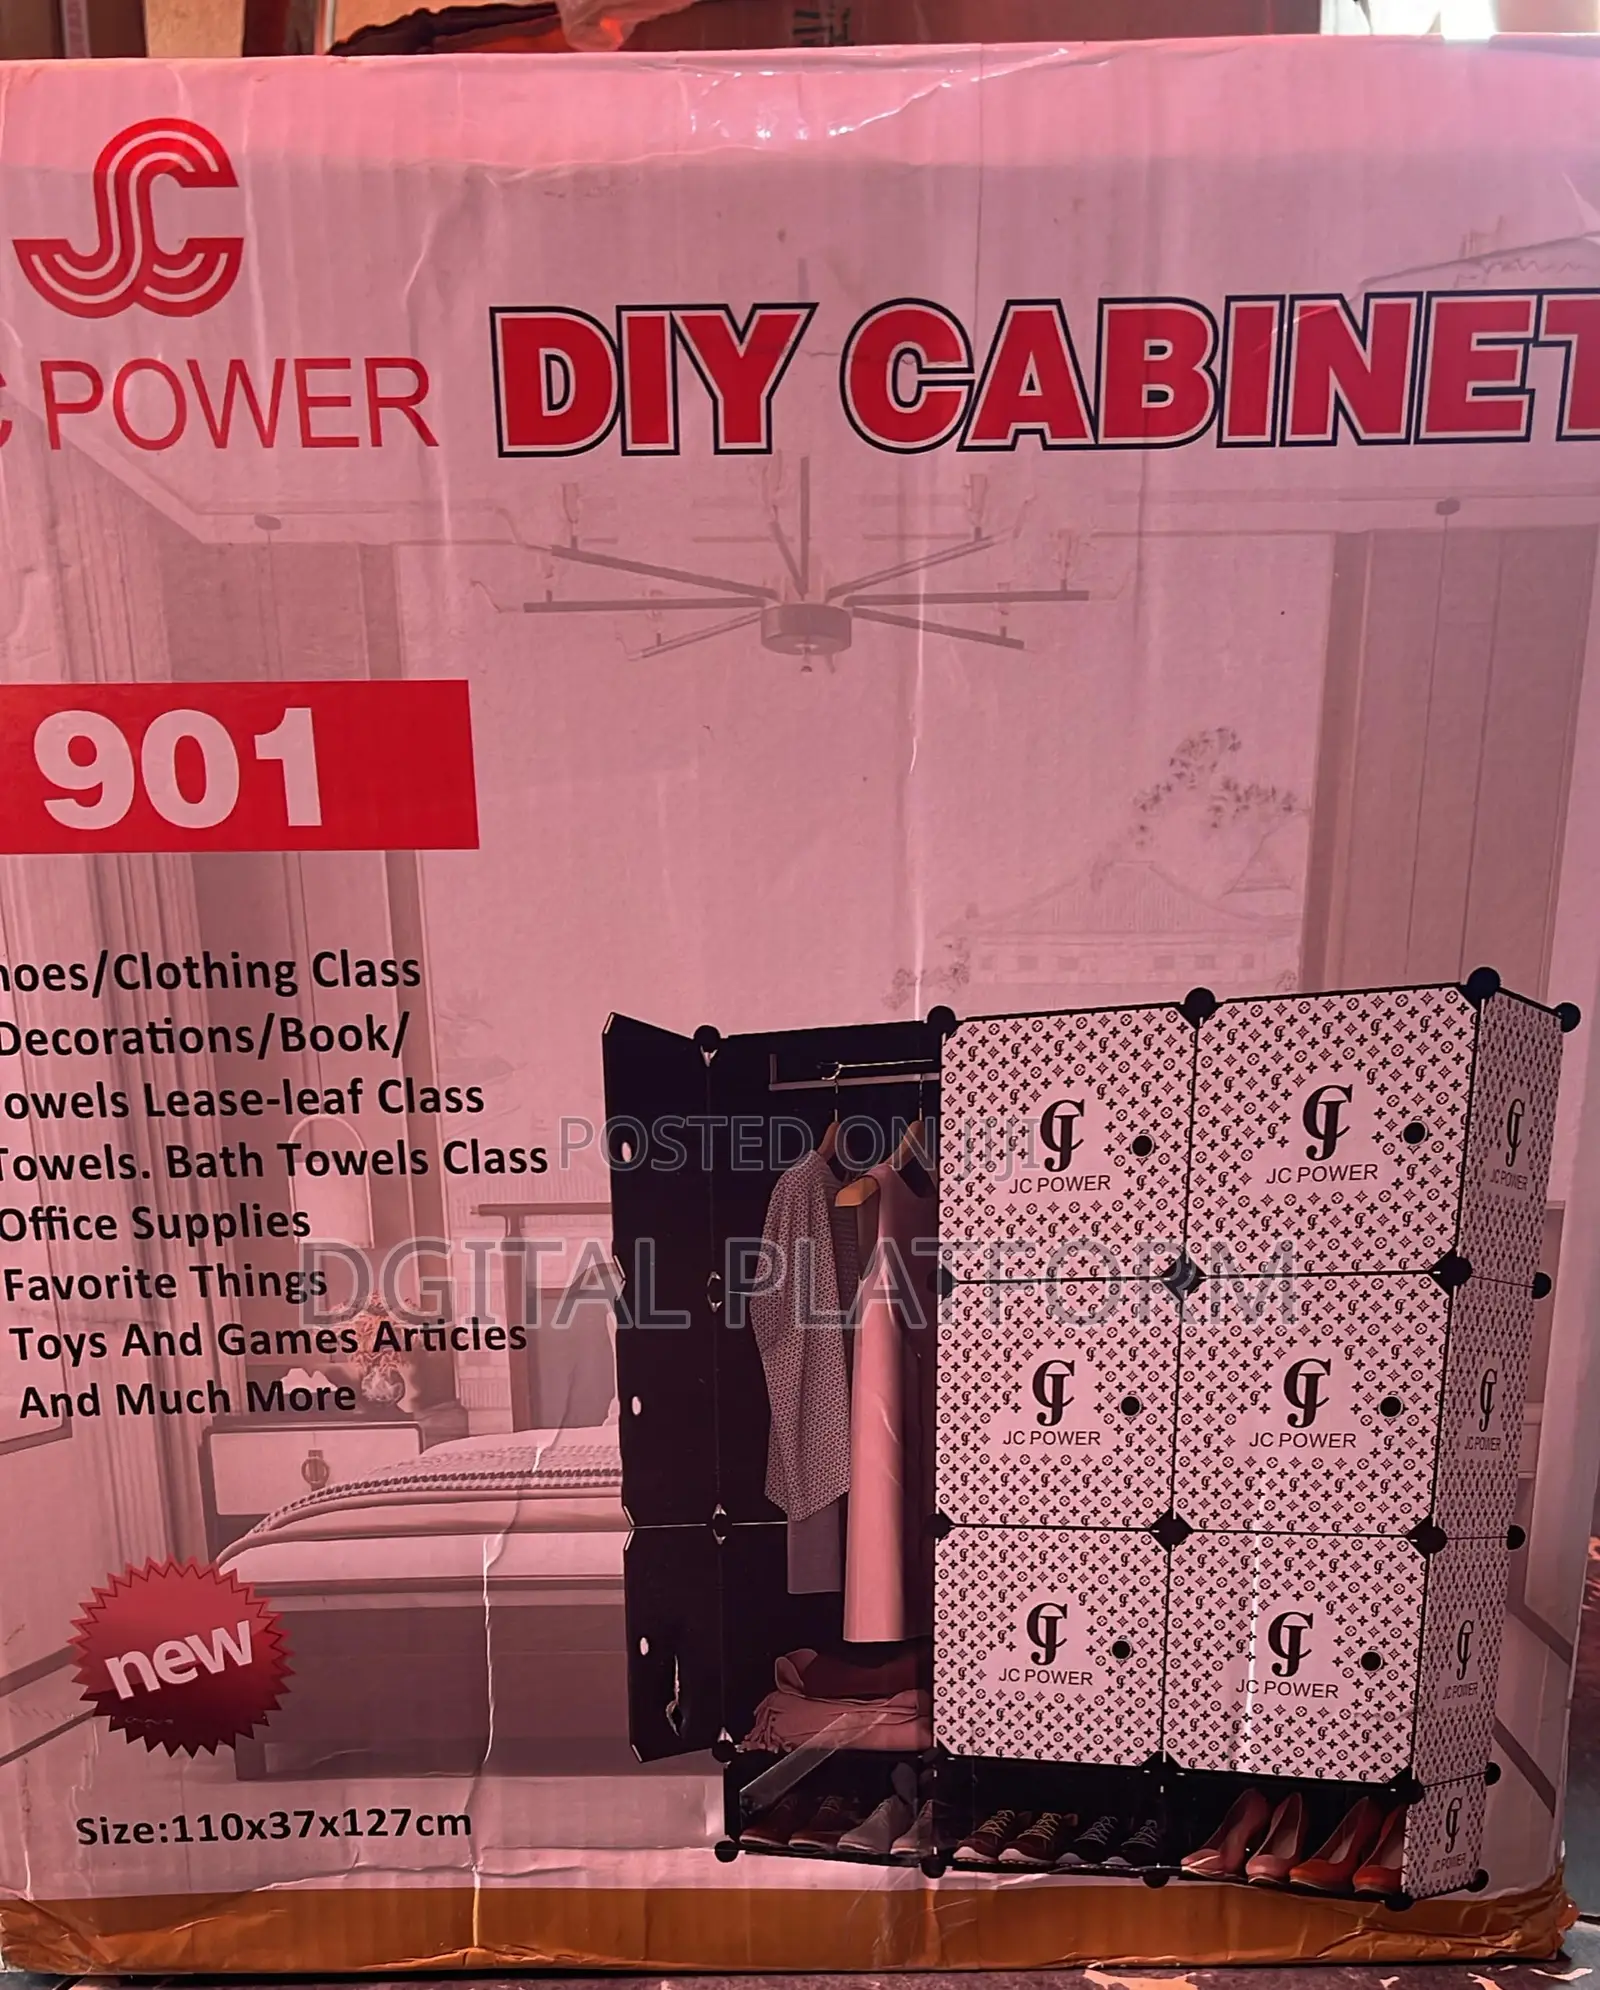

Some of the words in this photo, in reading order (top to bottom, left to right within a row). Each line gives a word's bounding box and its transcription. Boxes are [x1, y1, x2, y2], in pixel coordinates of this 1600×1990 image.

[490, 303, 818, 457] DIY
[840, 288, 1600, 454] CABINET
[40, 357, 440, 450] POWER
[34, 707, 322, 830] 901
[313, 949, 421, 988] Class
[0, 1011, 410, 1060] Decorations/Book/
[144, 1077, 364, 1117] Lease-leaf
[378, 1077, 485, 1115] Class
[166, 1143, 264, 1179] Bath
[278, 1139, 429, 1177] Towels
[443, 1138, 548, 1174] Class
[1265, 1167, 1292, 1184] JC
[1297, 1163, 1378, 1183] POWER
[1009, 1178, 1032, 1194] JC
[1037, 1175, 1111, 1193] POWER
[0, 1205, 118, 1244] Office
[132, 1203, 311, 1248] Supplies
[4, 1267, 177, 1302] Favorite
[190, 1263, 328, 1304] Things
[9, 1326, 107, 1367] Toys
[122, 1321, 202, 1357] And
[218, 1323, 359, 1356] Games
[372, 1315, 527, 1352] Articles
[19, 1383, 100, 1419] And
[117, 1381, 231, 1415] Much
[247, 1380, 356, 1412] More
[1003, 1431, 1025, 1445] JC
[1030, 1431, 1101, 1445] POWER
[1249, 1432, 1274, 1448] JC
[1279, 1432, 1357, 1448] POWER
[105, 1619, 253, 1699] new
[999, 1668, 1020, 1682] JC
[1025, 1669, 1093, 1686] POWER
[1236, 1679, 1259, 1694] JC
[1264, 1681, 1339, 1699] POWER
[76, 1807, 472, 1845] Size:110x37x127cm
